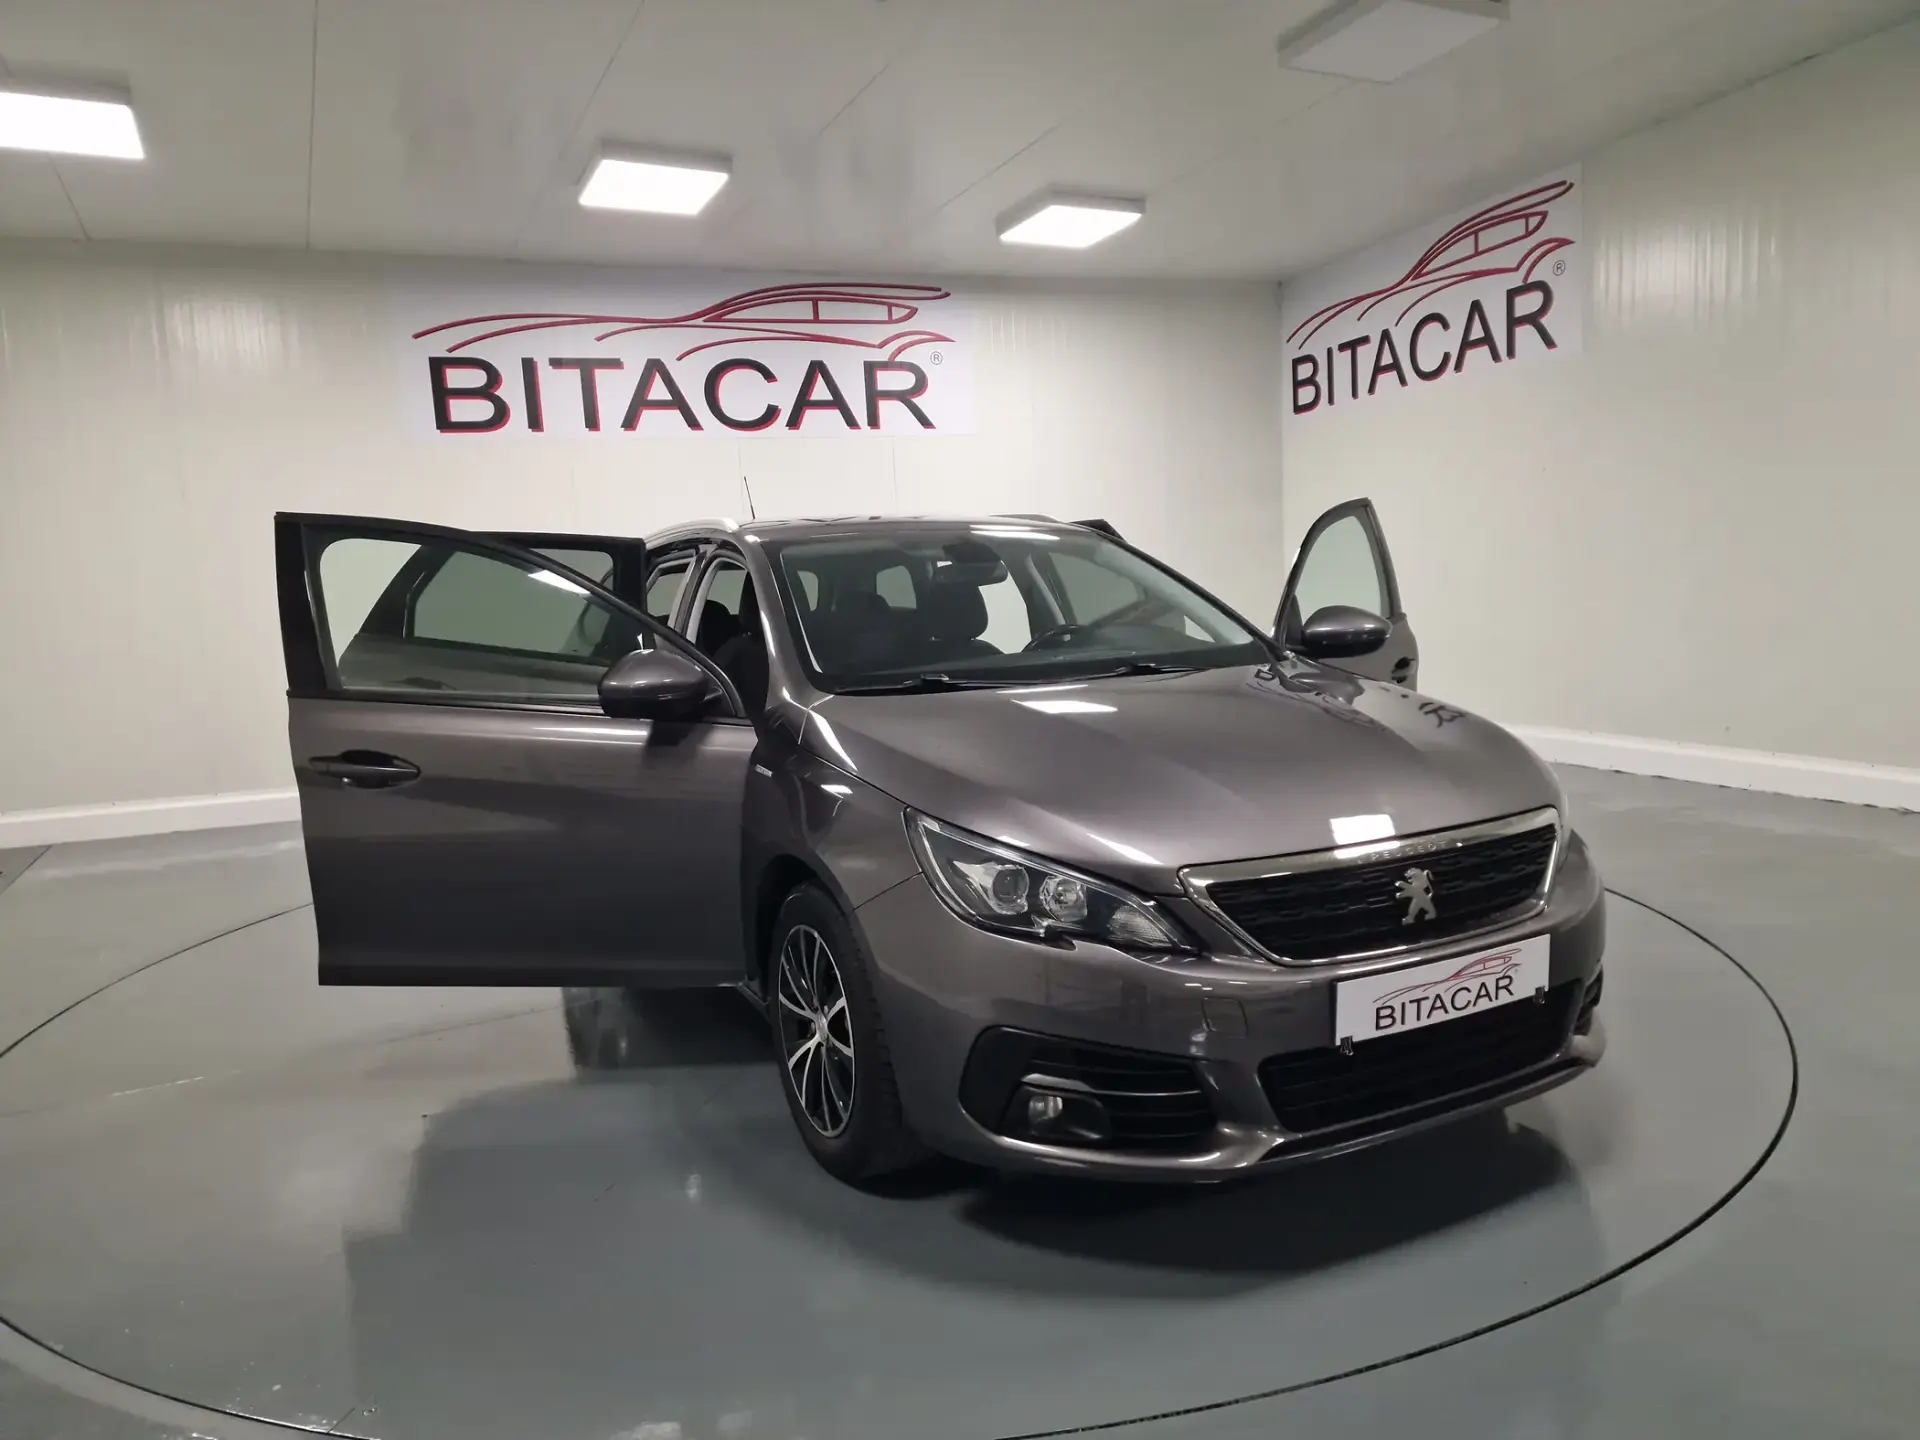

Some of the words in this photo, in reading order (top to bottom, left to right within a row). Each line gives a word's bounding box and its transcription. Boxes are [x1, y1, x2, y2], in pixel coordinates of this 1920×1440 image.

[1291, 279, 1558, 416] BITACAR
[428, 356, 936, 433] BITACAR
[1375, 975, 1515, 1031] BITACAR
